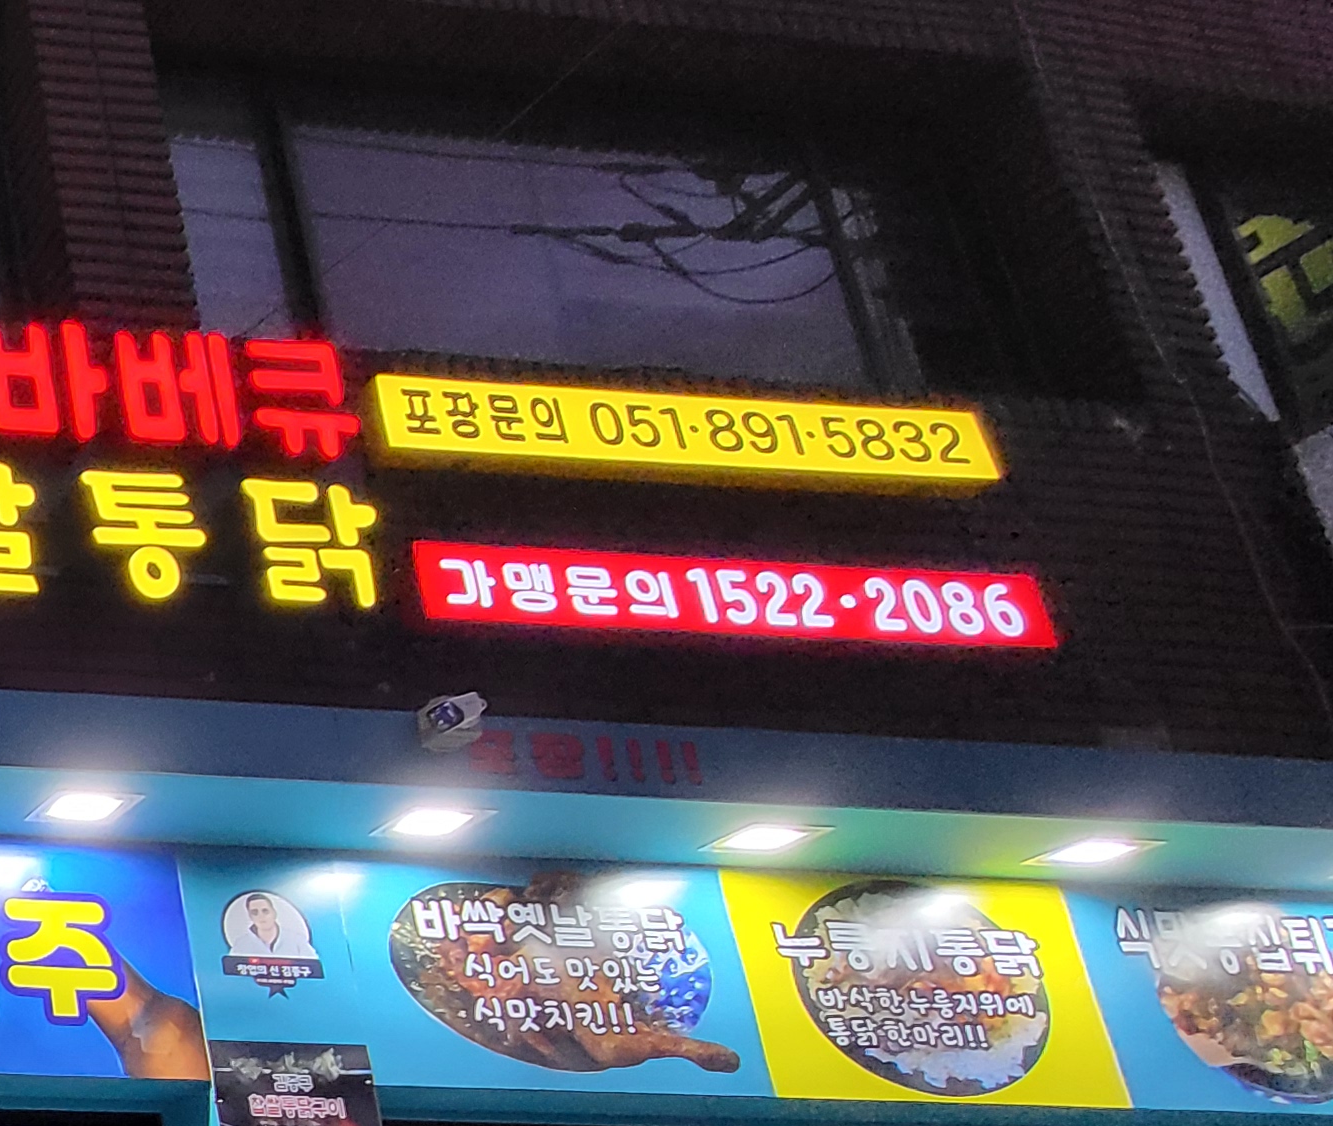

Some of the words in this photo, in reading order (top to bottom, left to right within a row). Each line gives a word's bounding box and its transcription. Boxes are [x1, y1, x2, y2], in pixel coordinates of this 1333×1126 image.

[403, 390, 567, 444] 포장문의
[442, 557, 678, 620] 가맹문의
[464, 953, 560, 987] 식어도
[567, 957, 662, 995] 맛있는
[474, 998, 637, 1037] 식맛치킨!!
